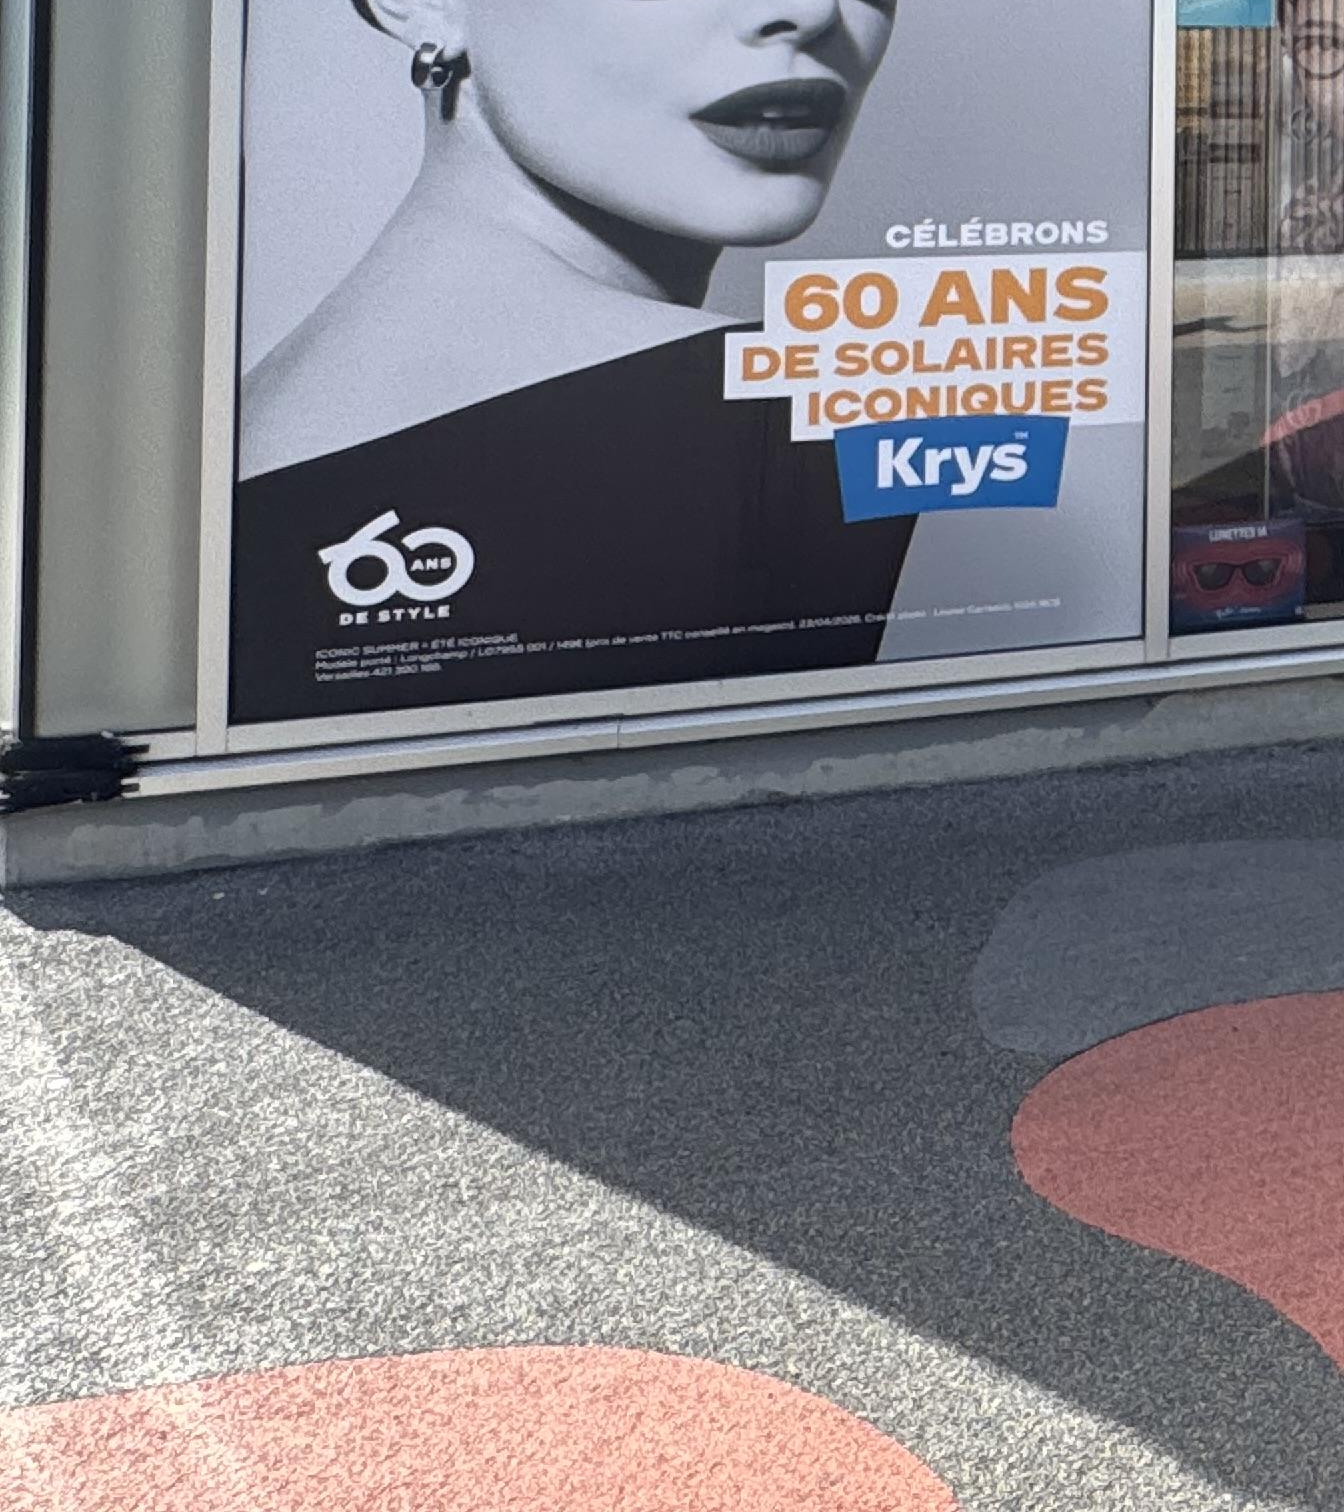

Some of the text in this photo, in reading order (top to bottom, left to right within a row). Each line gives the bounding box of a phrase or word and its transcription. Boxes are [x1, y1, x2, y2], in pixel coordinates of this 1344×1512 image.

[885, 217, 1109, 249] CÉLÉBRONS
[784, 266, 1110, 332] 60 ANS
[741, 332, 1109, 383] DE SOLAIRES
[808, 378, 1108, 426] ICONIQUES
[877, 437, 1029, 496] Krys
[317, 509, 475, 607] 60 ANS
[339, 604, 451, 626] DE STYLE
[661, 630, 682, 641] TTC
[315, 646, 360, 659] ICONIC
[363, 640, 419, 655] SUMMER
